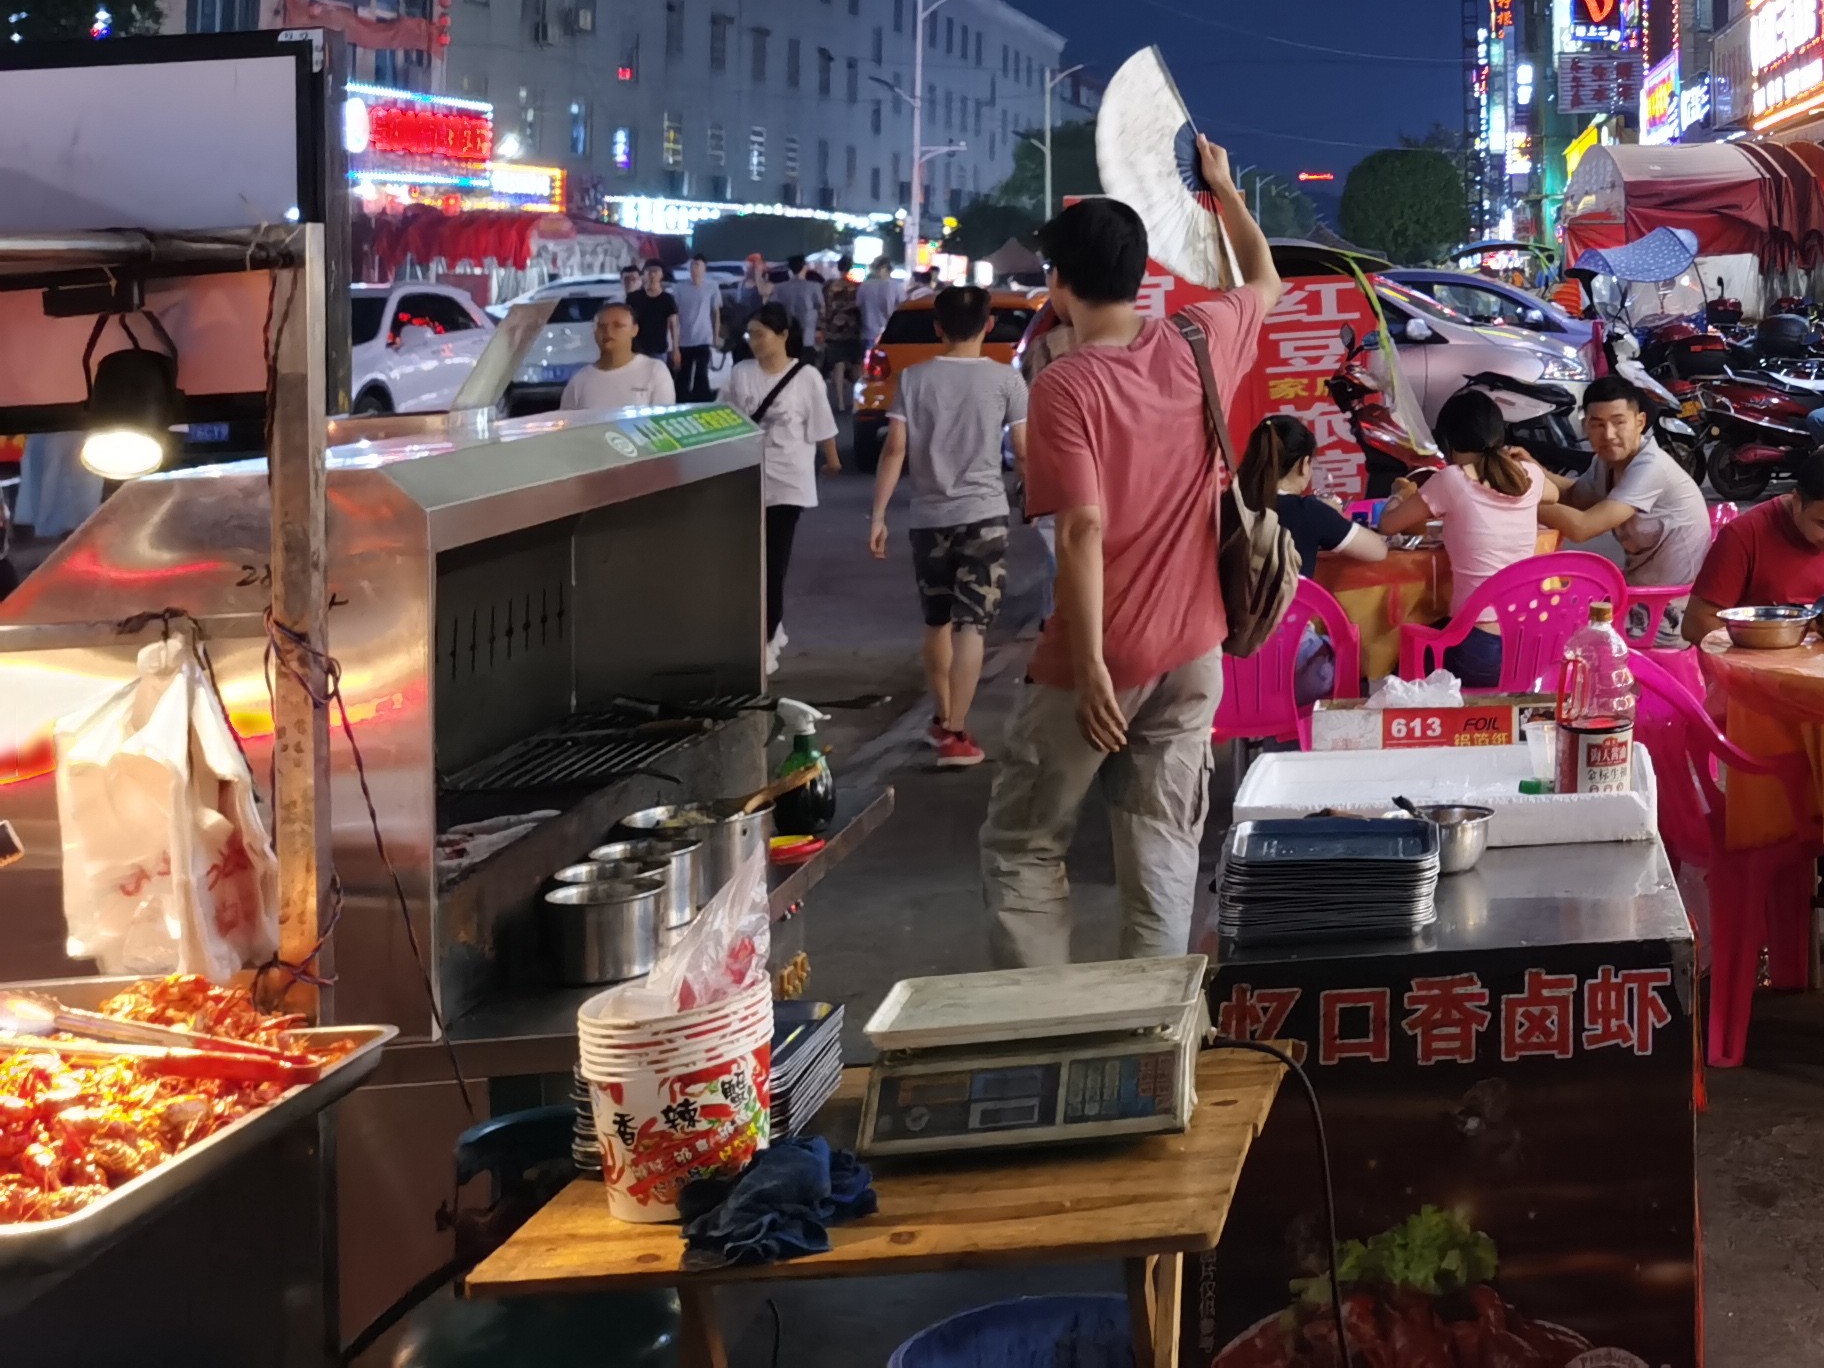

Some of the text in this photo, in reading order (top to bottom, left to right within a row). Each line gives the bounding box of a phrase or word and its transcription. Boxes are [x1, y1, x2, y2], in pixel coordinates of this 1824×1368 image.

[1264, 281, 1361, 374] 红豆
[1391, 717, 1499, 738] 613 FOIL
[1219, 965, 1672, 1066] 忆口香卤虾
